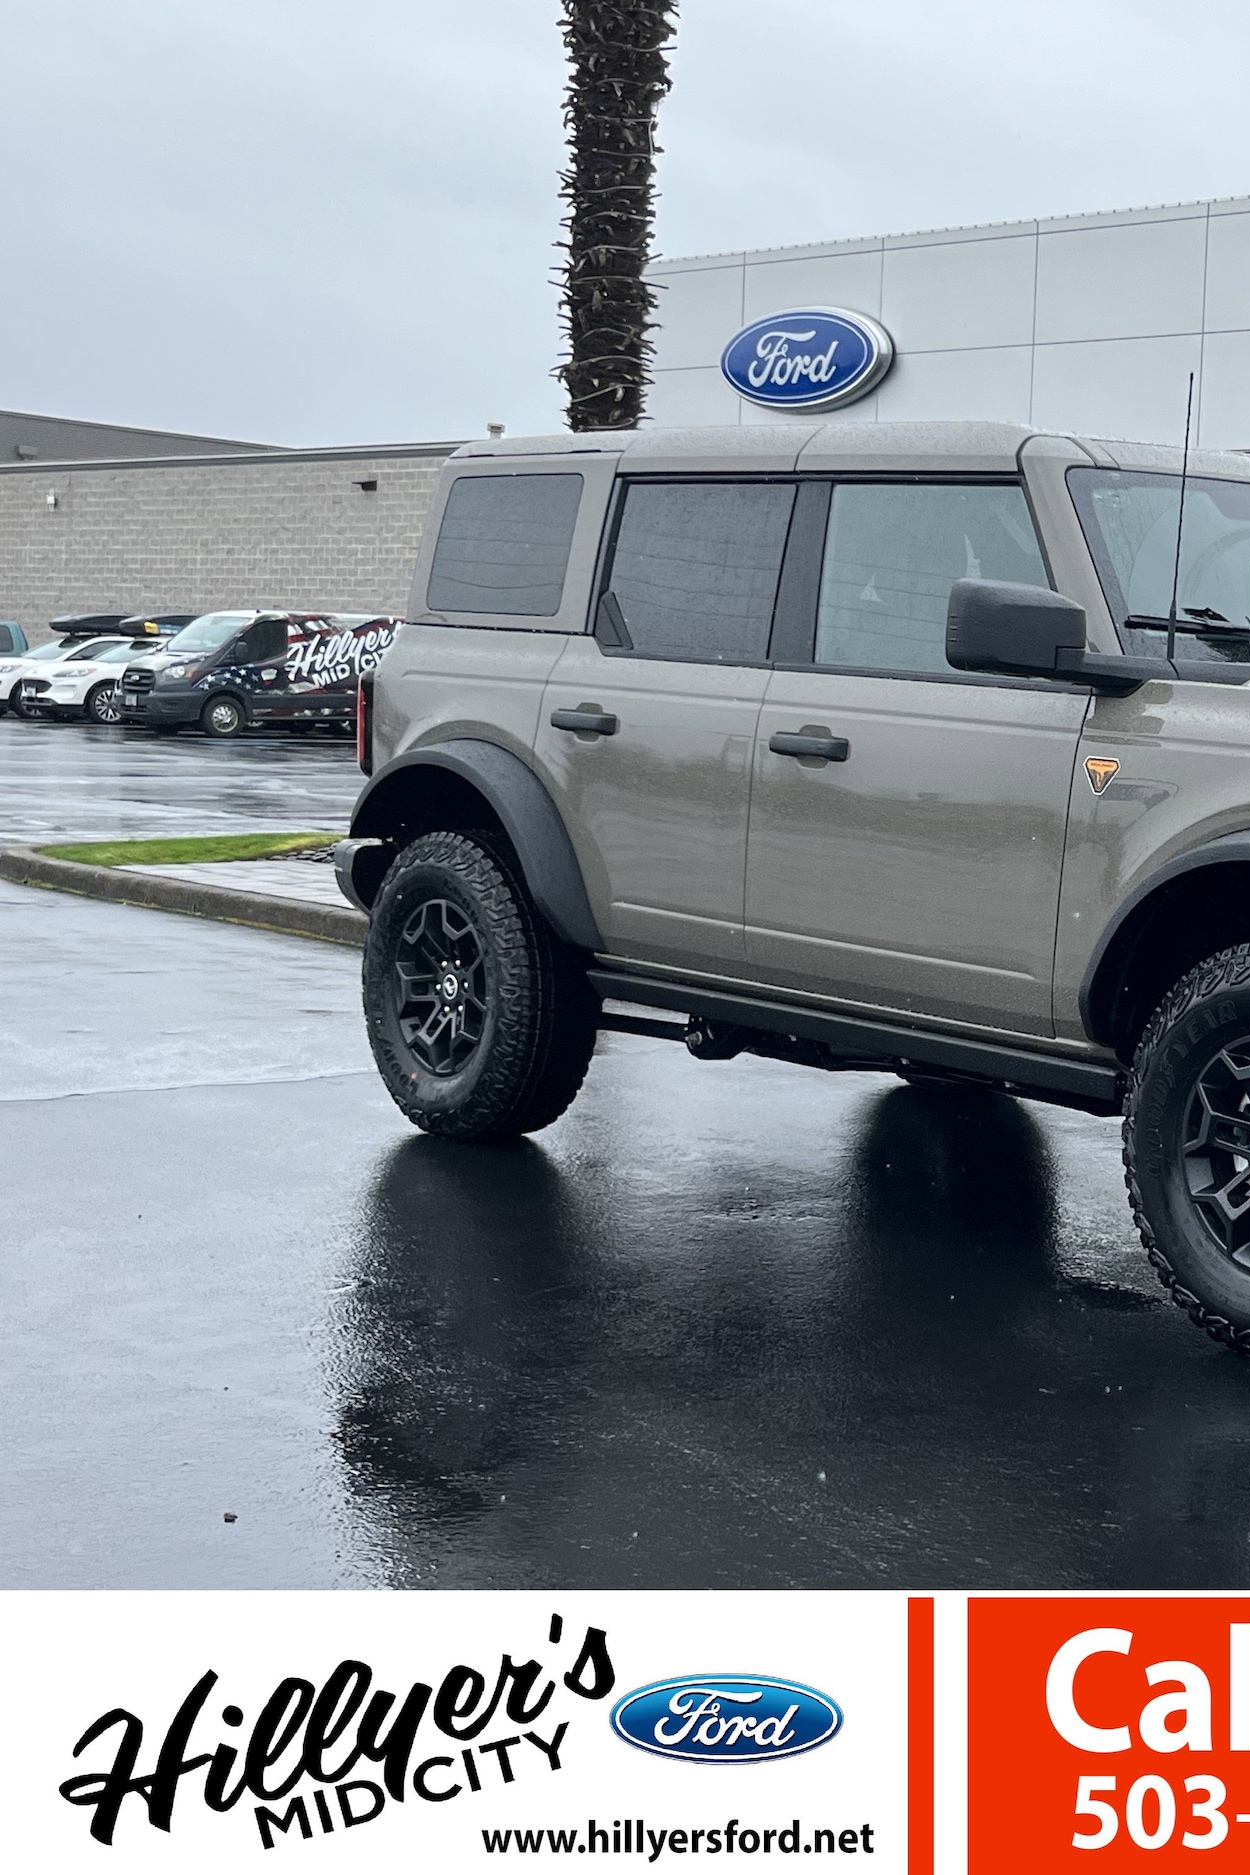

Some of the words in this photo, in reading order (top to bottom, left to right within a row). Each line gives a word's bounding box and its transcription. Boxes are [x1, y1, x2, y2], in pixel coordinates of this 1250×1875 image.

[748, 330, 839, 388] Ford
[312, 664, 351, 688] MID
[1143, 1001, 1238, 1177] GOODYEAR
